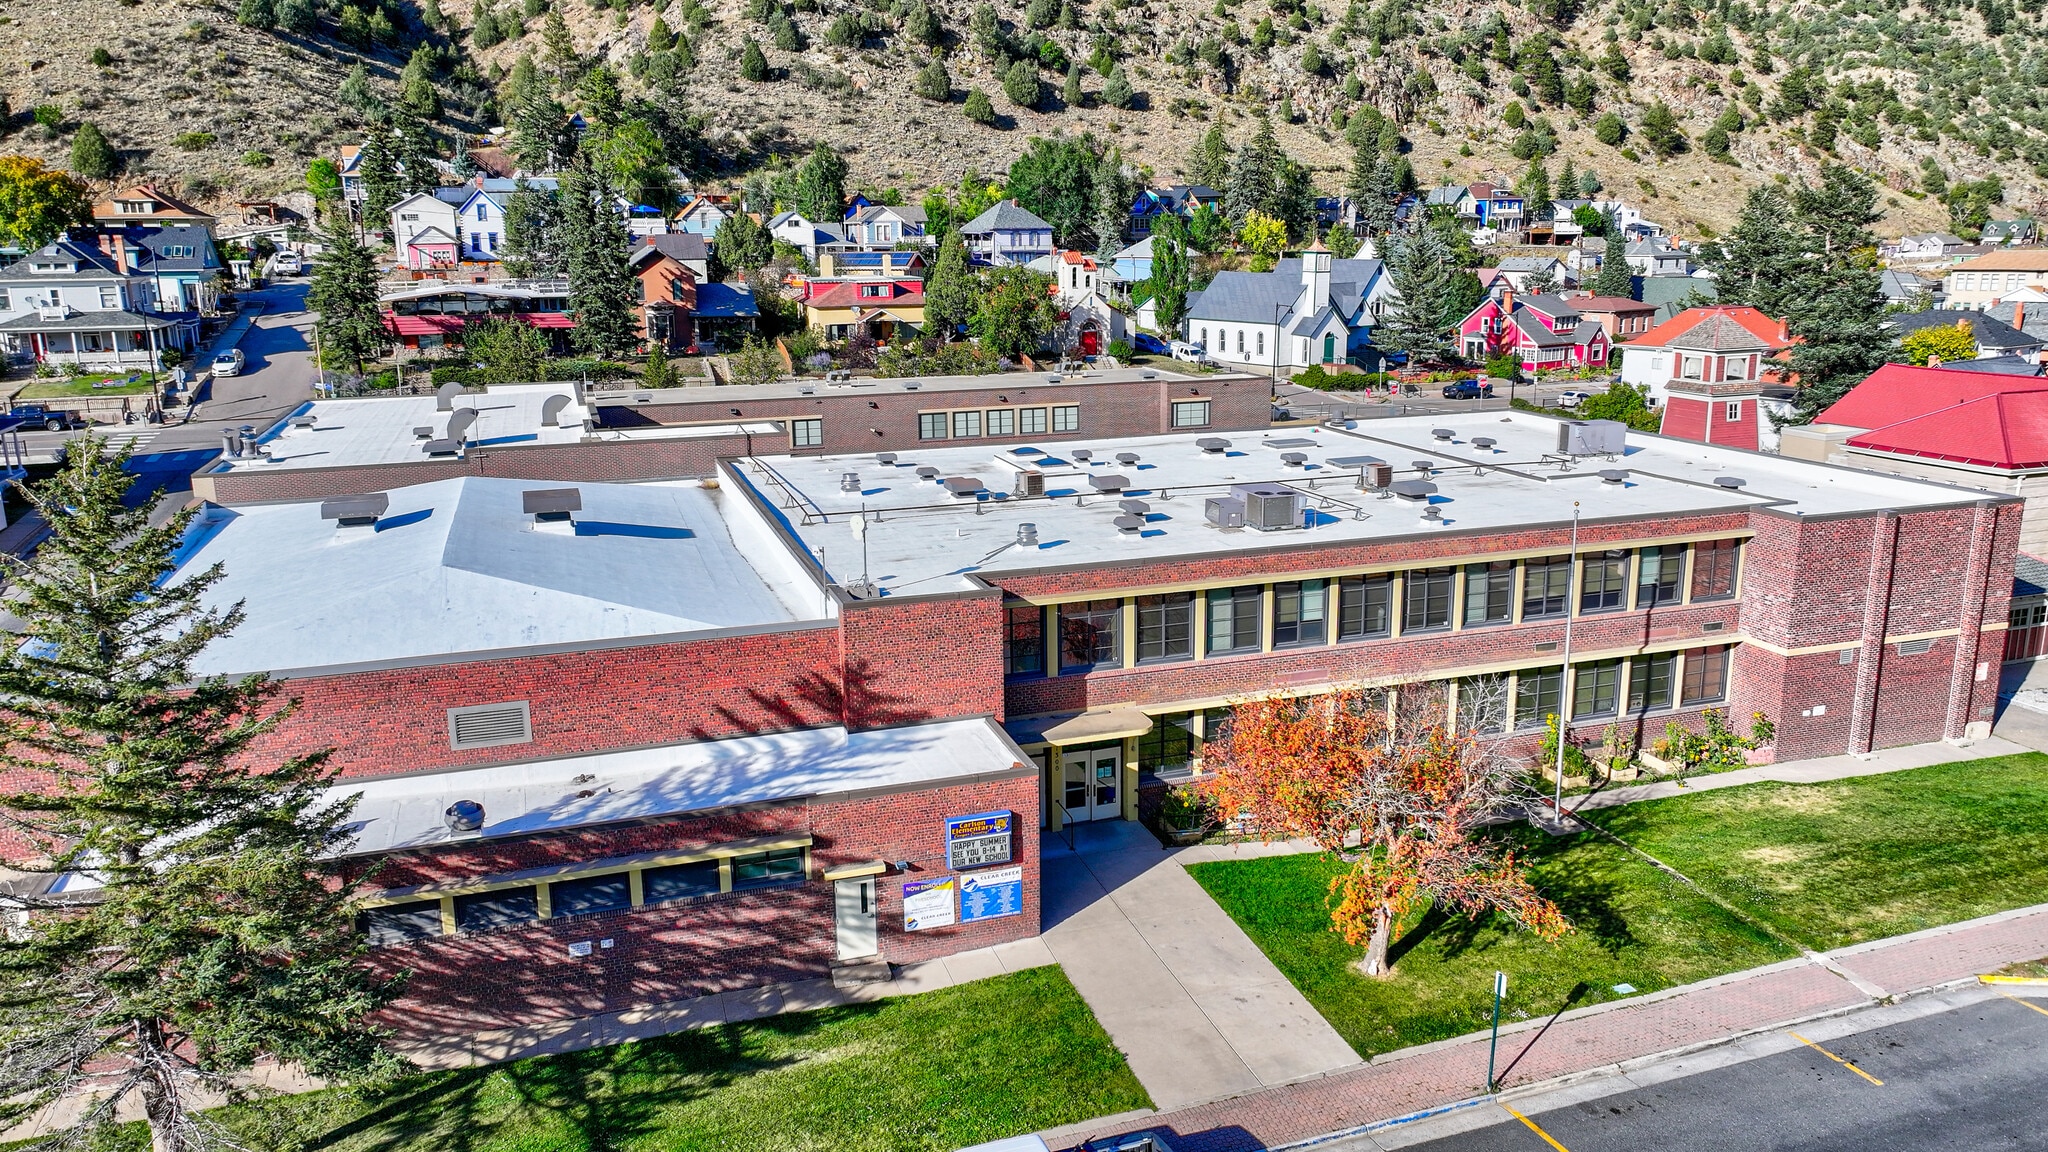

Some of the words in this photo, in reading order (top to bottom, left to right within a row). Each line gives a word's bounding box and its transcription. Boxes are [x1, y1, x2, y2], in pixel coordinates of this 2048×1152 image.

[951, 824, 993, 834] Elementary
[960, 820, 986, 828] Carlson
[954, 842, 975, 850] HAPPY
[980, 837, 1006, 846] SUMMER
[982, 846, 996, 854] 8-14
[952, 858, 966, 866] OUR
[968, 856, 981, 864] NEW
[985, 852, 1008, 861] SCHOOL
